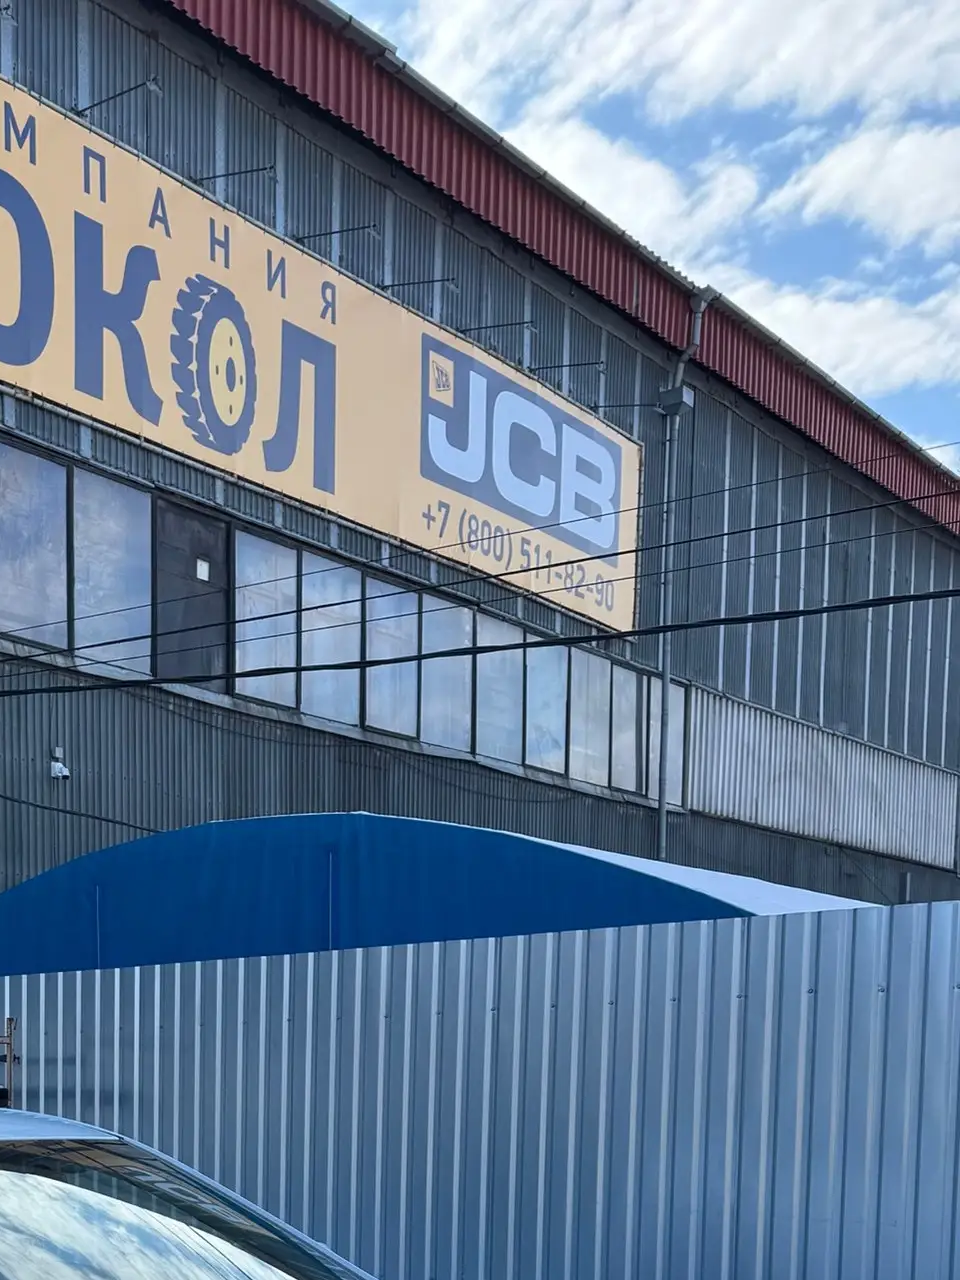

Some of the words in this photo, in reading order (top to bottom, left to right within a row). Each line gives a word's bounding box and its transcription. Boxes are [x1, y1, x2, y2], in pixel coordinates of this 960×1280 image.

[428, 370, 616, 549] JCB
[422, 499, 451, 538] +7
[458, 508, 513, 571] (800)
[519, 537, 615, 612] 511-82-90
